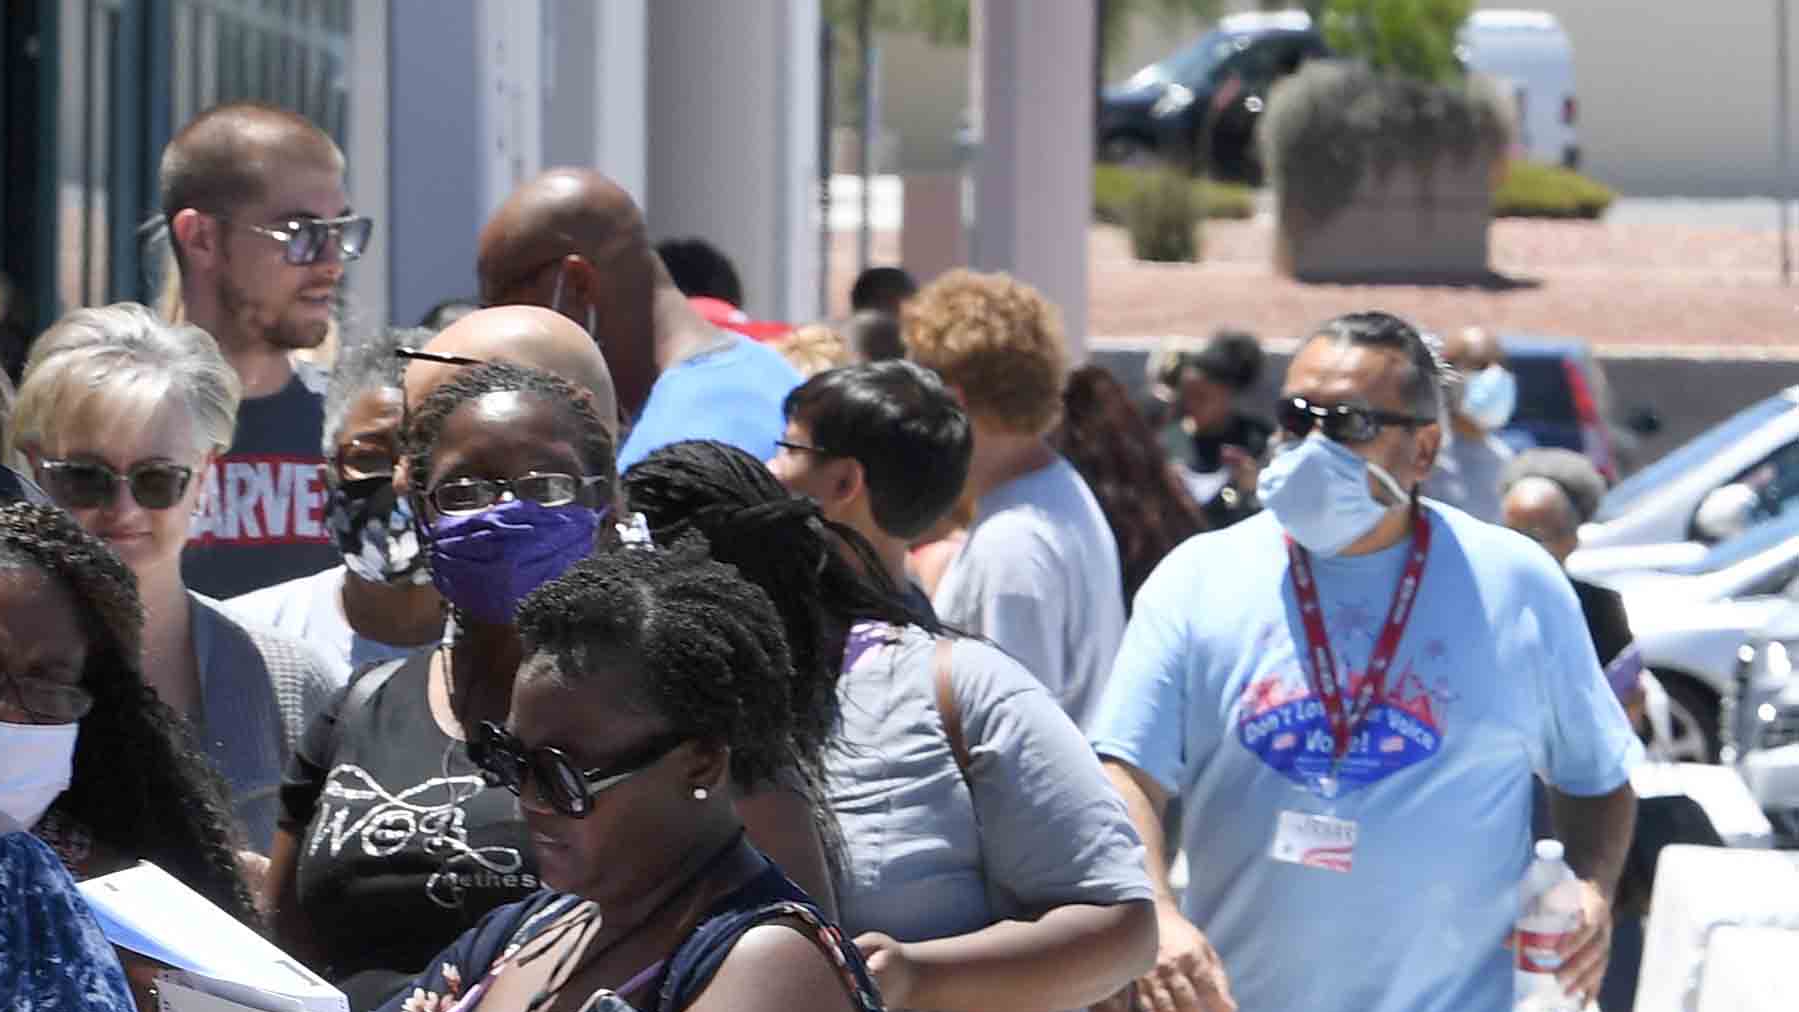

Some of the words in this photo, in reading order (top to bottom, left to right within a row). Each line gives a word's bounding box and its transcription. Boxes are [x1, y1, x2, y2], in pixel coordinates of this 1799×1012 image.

[187, 461, 328, 538] ARVE
[1244, 706, 1291, 744] Don't
[1387, 707, 1436, 750] Voice
